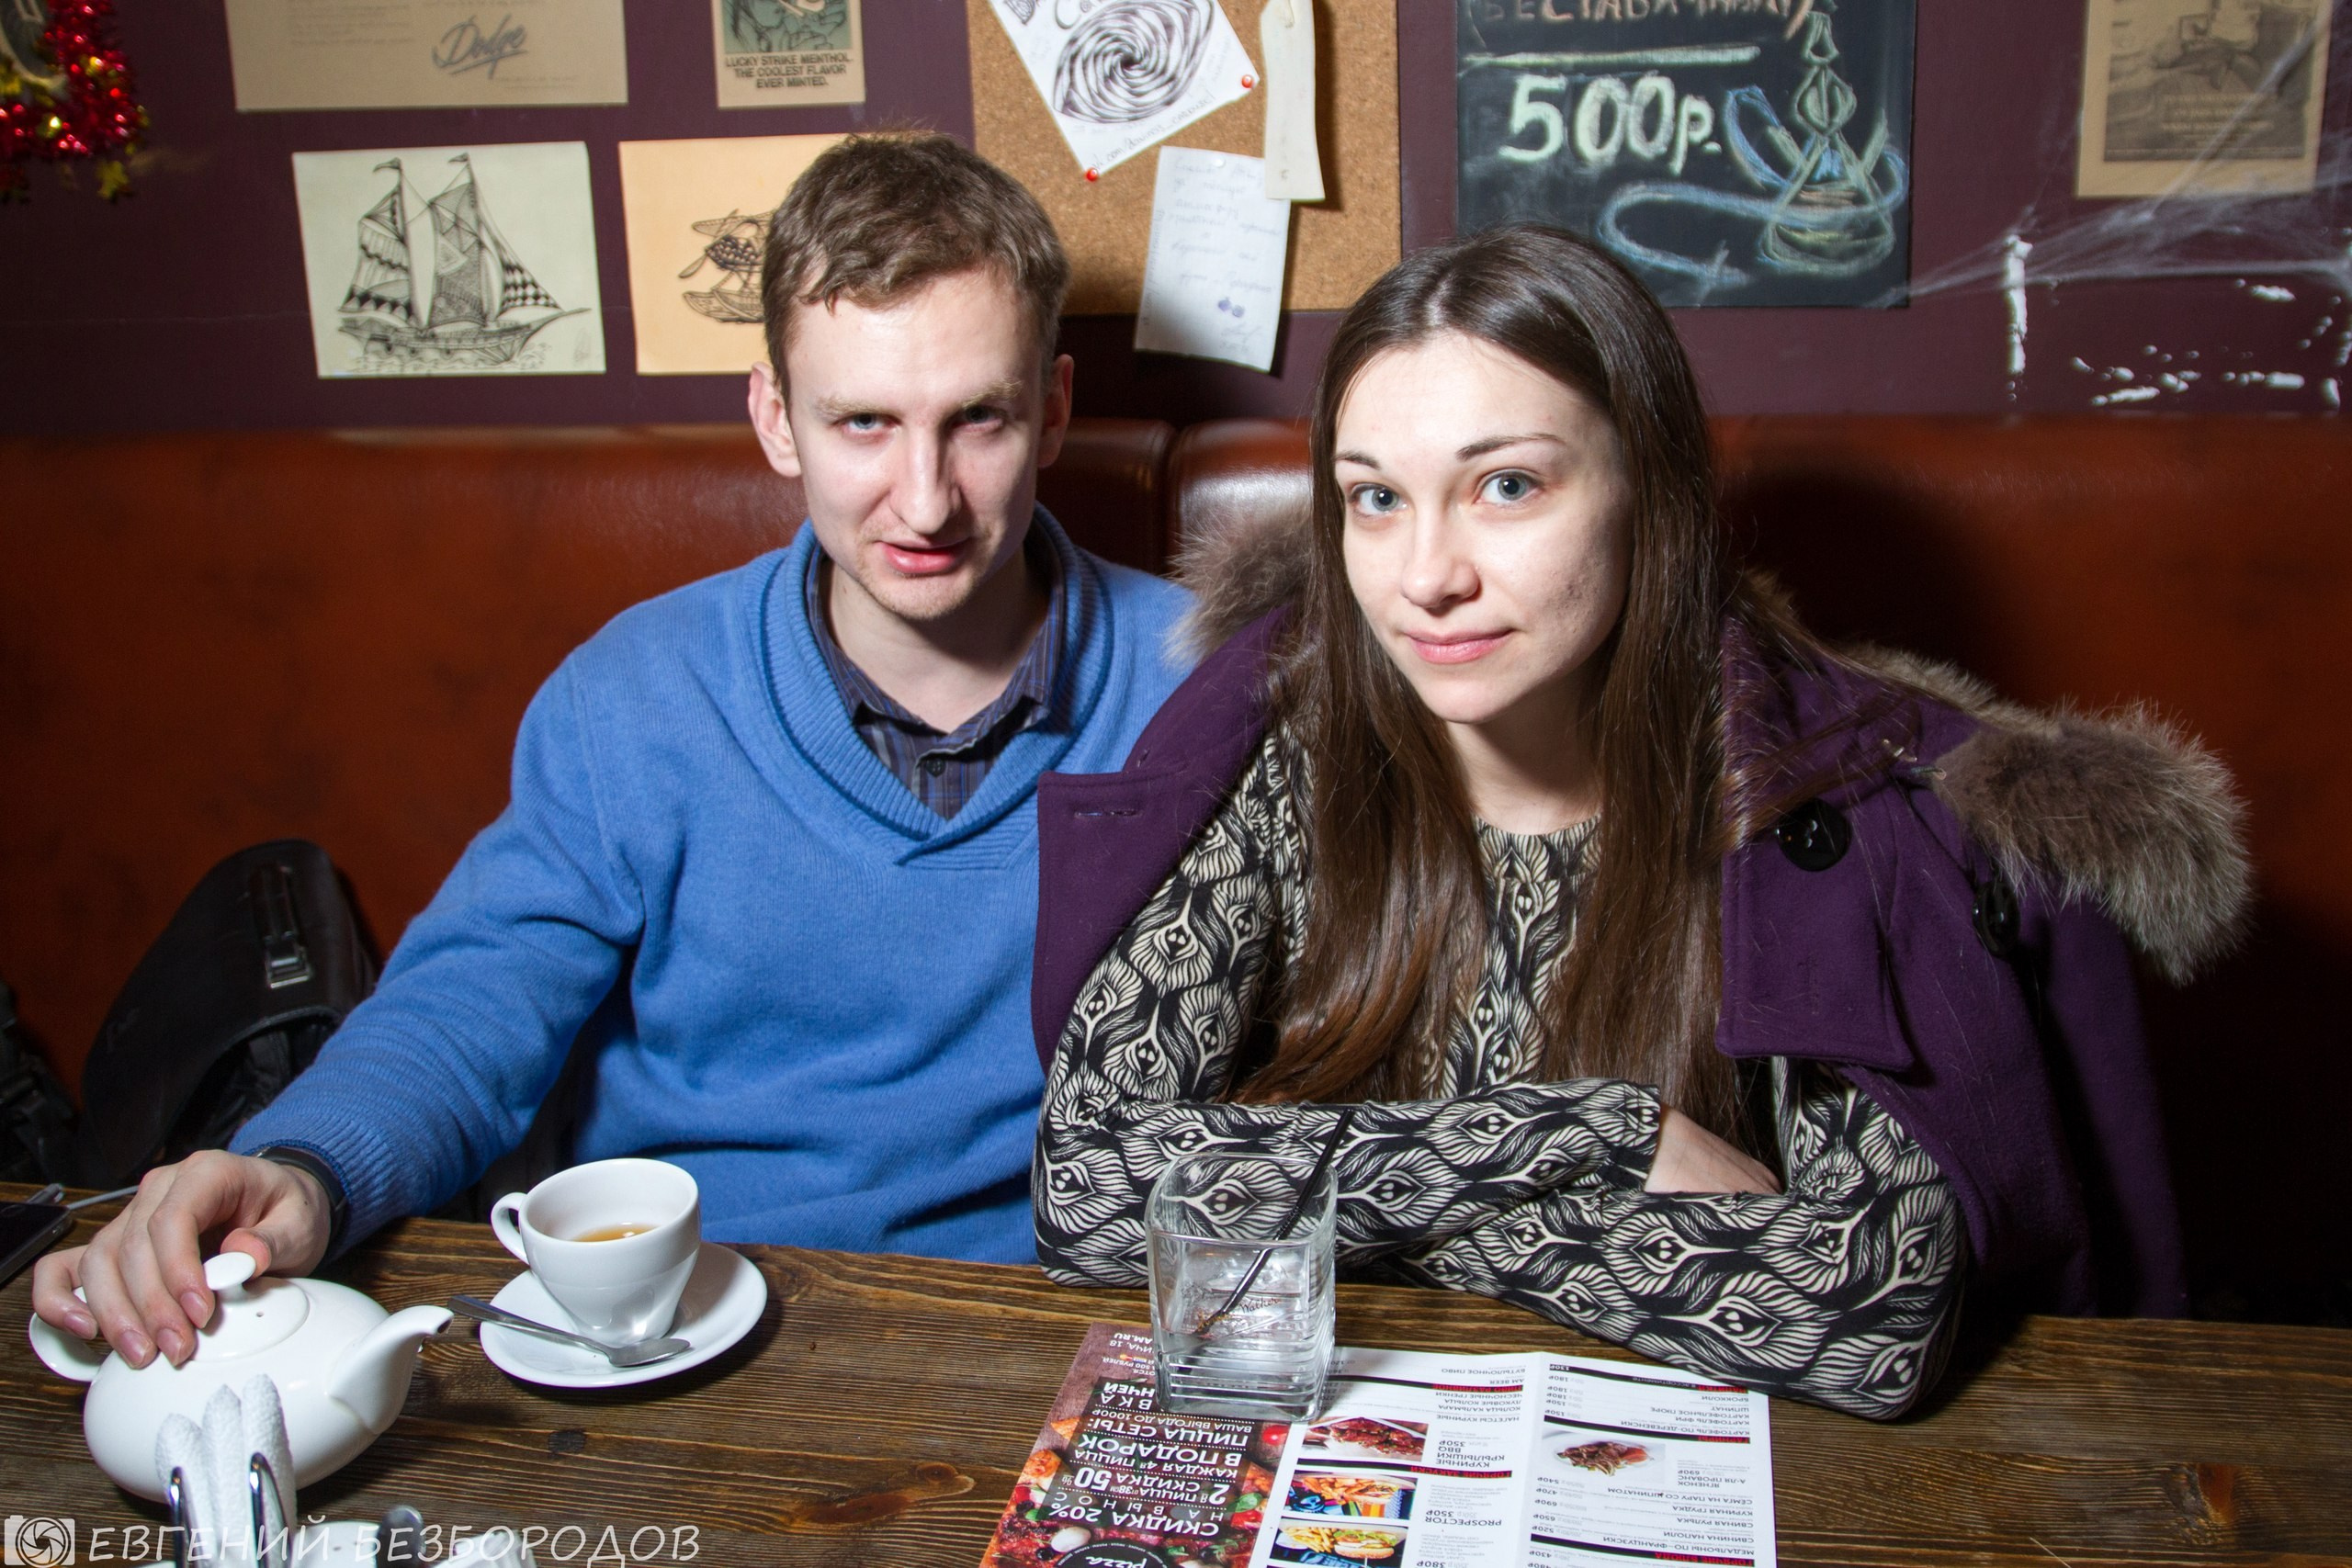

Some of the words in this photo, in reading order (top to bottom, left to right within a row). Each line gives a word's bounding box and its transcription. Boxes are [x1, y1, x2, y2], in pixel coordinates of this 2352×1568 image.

[726, 55, 758, 67] LUCKY
[762, 54, 797, 66] STRIKE
[735, 67, 754, 77] THE
[757, 65, 805, 76] COOLEST
[808, 64, 846, 75] FLAVOR
[757, 77, 784, 88] EVER
[1701, 1394, 1749, 1403] БРОККОЛИ
[1437, 1404, 1484, 1413] КАЛЬМАРА
[1649, 1406, 1676, 1415] ПЮРЕ
[1678, 1409, 1749, 1418] КАРТОФЕЛЬНОЕ
[1134, 1415, 1156, 1425] ДО
[1158, 1416, 1211, 1429] ВЫГОДА
[1696, 1416, 1749, 1426] КАРТОФЕЛЬ
[1086, 1417, 1157, 1437] СЕТЫ:
[1215, 1422, 1253, 1433] ВАША
[1621, 1420, 1694, 1433] ПО-ДЕРЕВЕНСКИ
[1696, 1427, 1749, 1436] КАРТОФЕЛЬ
[1163, 1427, 1249, 1447] ПИЦЦА
[1078, 1433, 1219, 1464] ПОДАРОК
[1074, 1449, 1136, 1468] ПИЦЦА
[1225, 1452, 1242, 1466] В
[1437, 1451, 1505, 1461] КРЫЛЫШКИ
[1435, 1459, 1490, 1468] КУРИНЫЕ
[1162, 1462, 1238, 1479] КАЖДАЯ
[1115, 1472, 1200, 1492] СКИДКА
[1678, 1474, 1722, 1483] ПРОВАНС
[1139, 1486, 1196, 1502] ПИЦЦА
[1681, 1493, 1705, 1501] ПАРУ
[1047, 1502, 1102, 1523] 20%
[1672, 1505, 1707, 1513] ГРУДКА
[1112, 1511, 1219, 1536] СКИДКА
[1424, 1516, 1502, 1527] PROSPECTOR
[1714, 1519, 1753, 1529] СВИНАЯ
[1663, 1531, 1704, 1540] НАПОЛИ
[1707, 1534, 1754, 1543] СВИНИНА
[1691, 1545, 1755, 1555] МЕДАЛЬОНЫ
